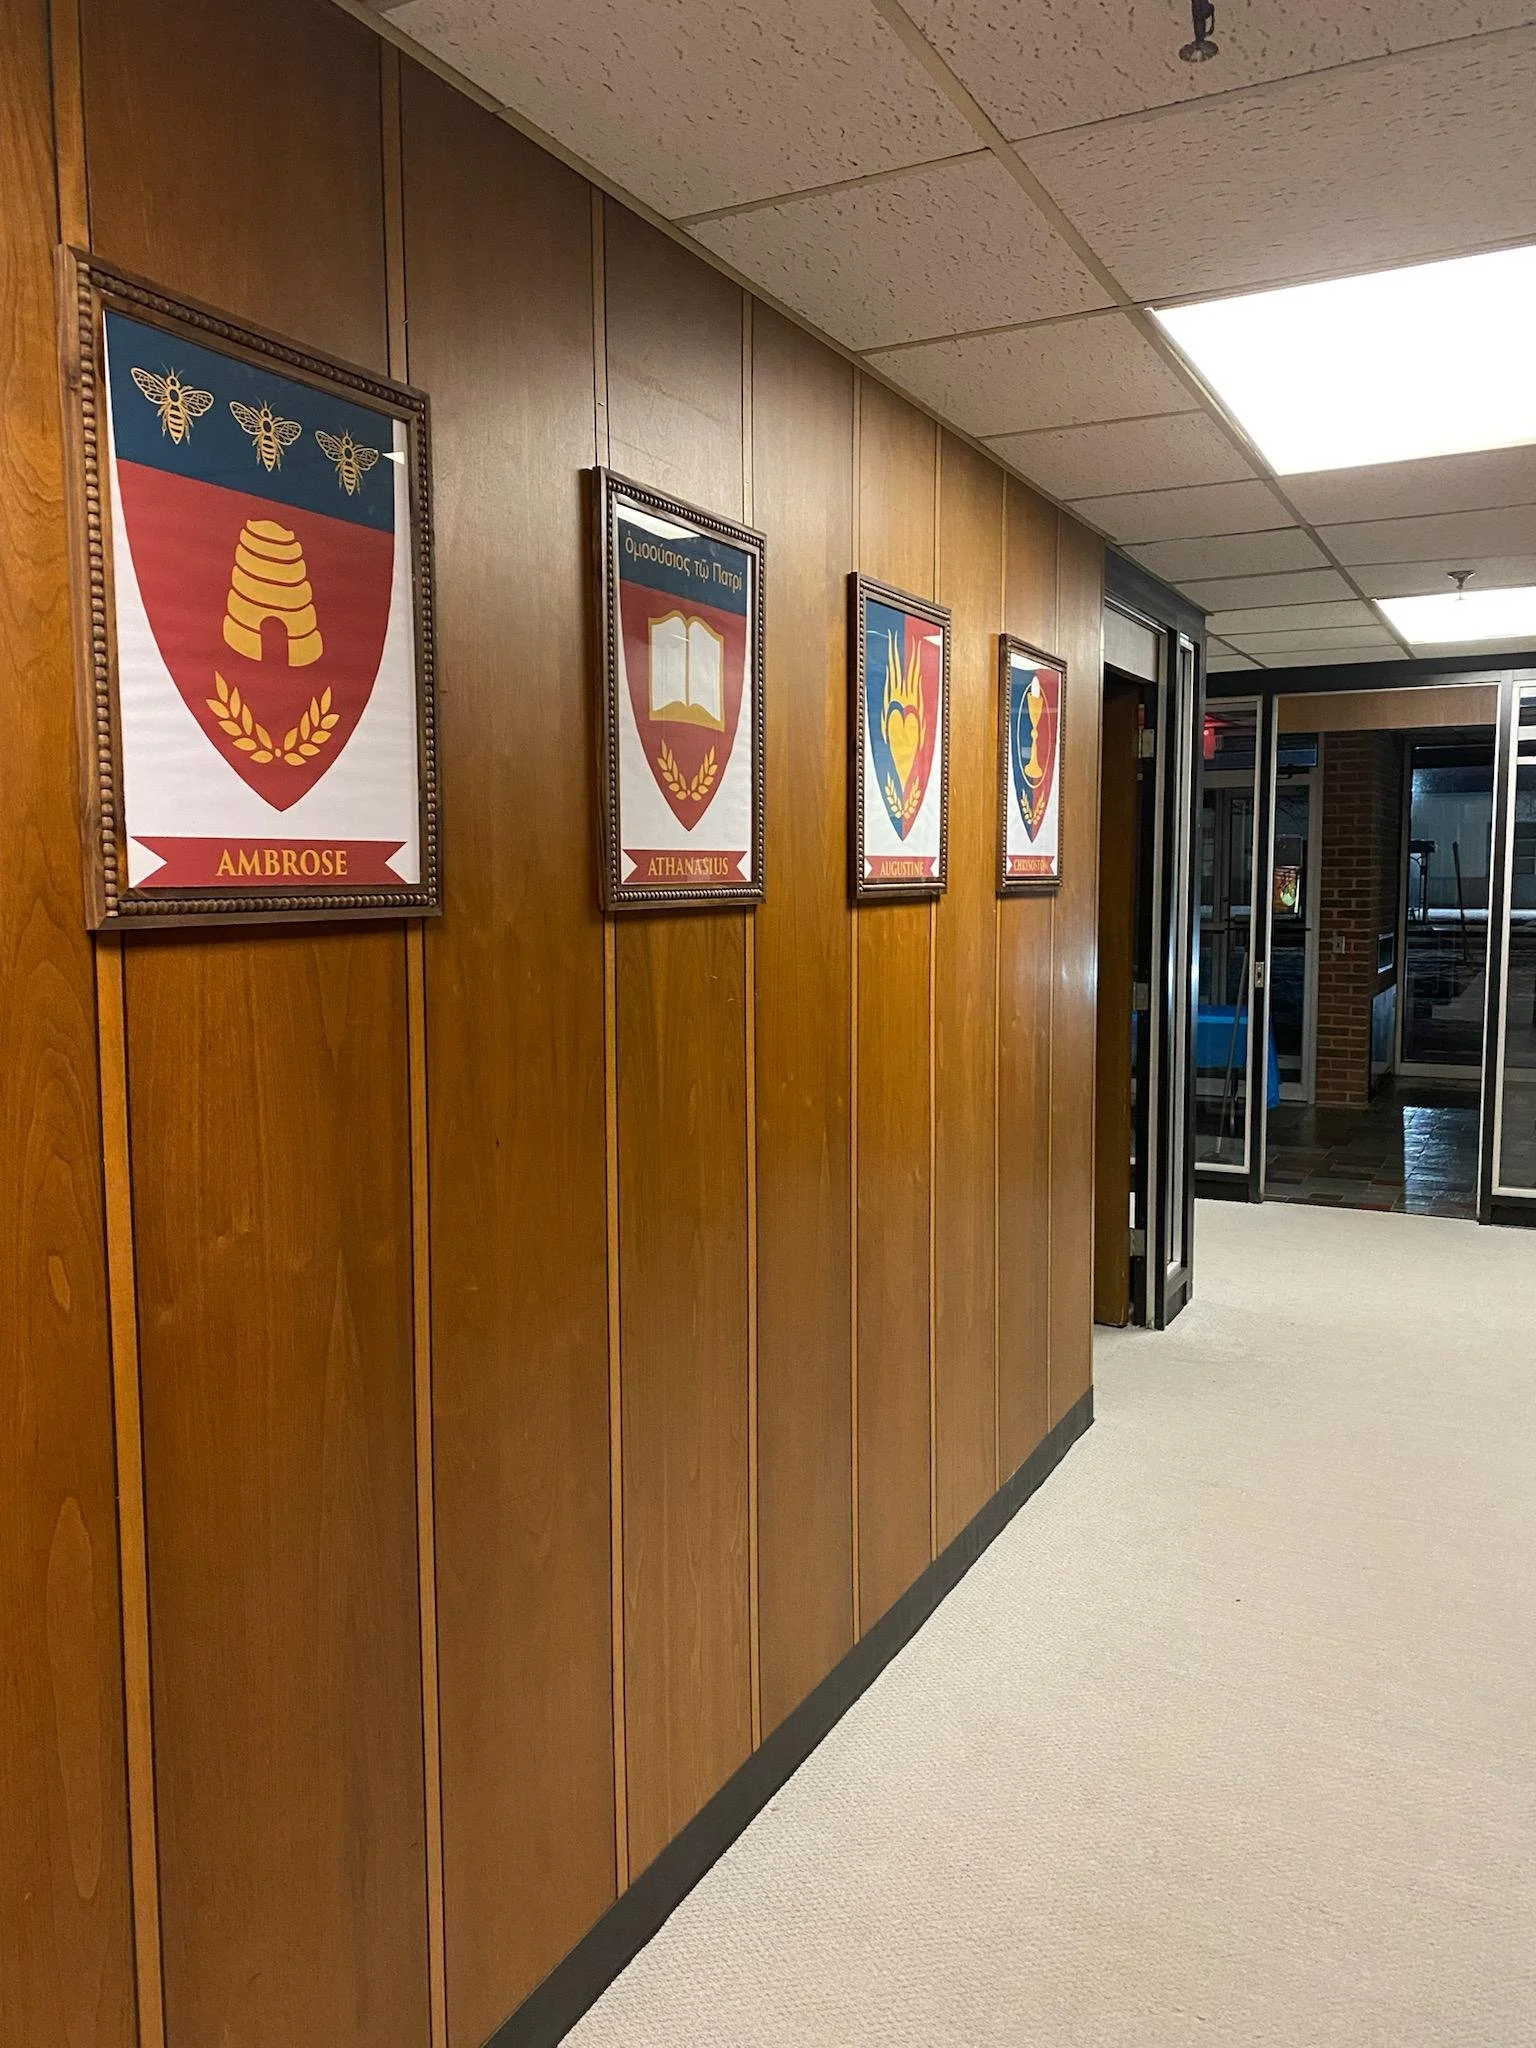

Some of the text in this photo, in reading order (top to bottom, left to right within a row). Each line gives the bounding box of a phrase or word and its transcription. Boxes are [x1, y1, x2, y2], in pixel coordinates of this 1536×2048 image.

[215, 848, 348, 877] AMBROSE
[647, 856, 729, 876] ATHANASIUS
[880, 860, 925, 877] AUGUSTINE
